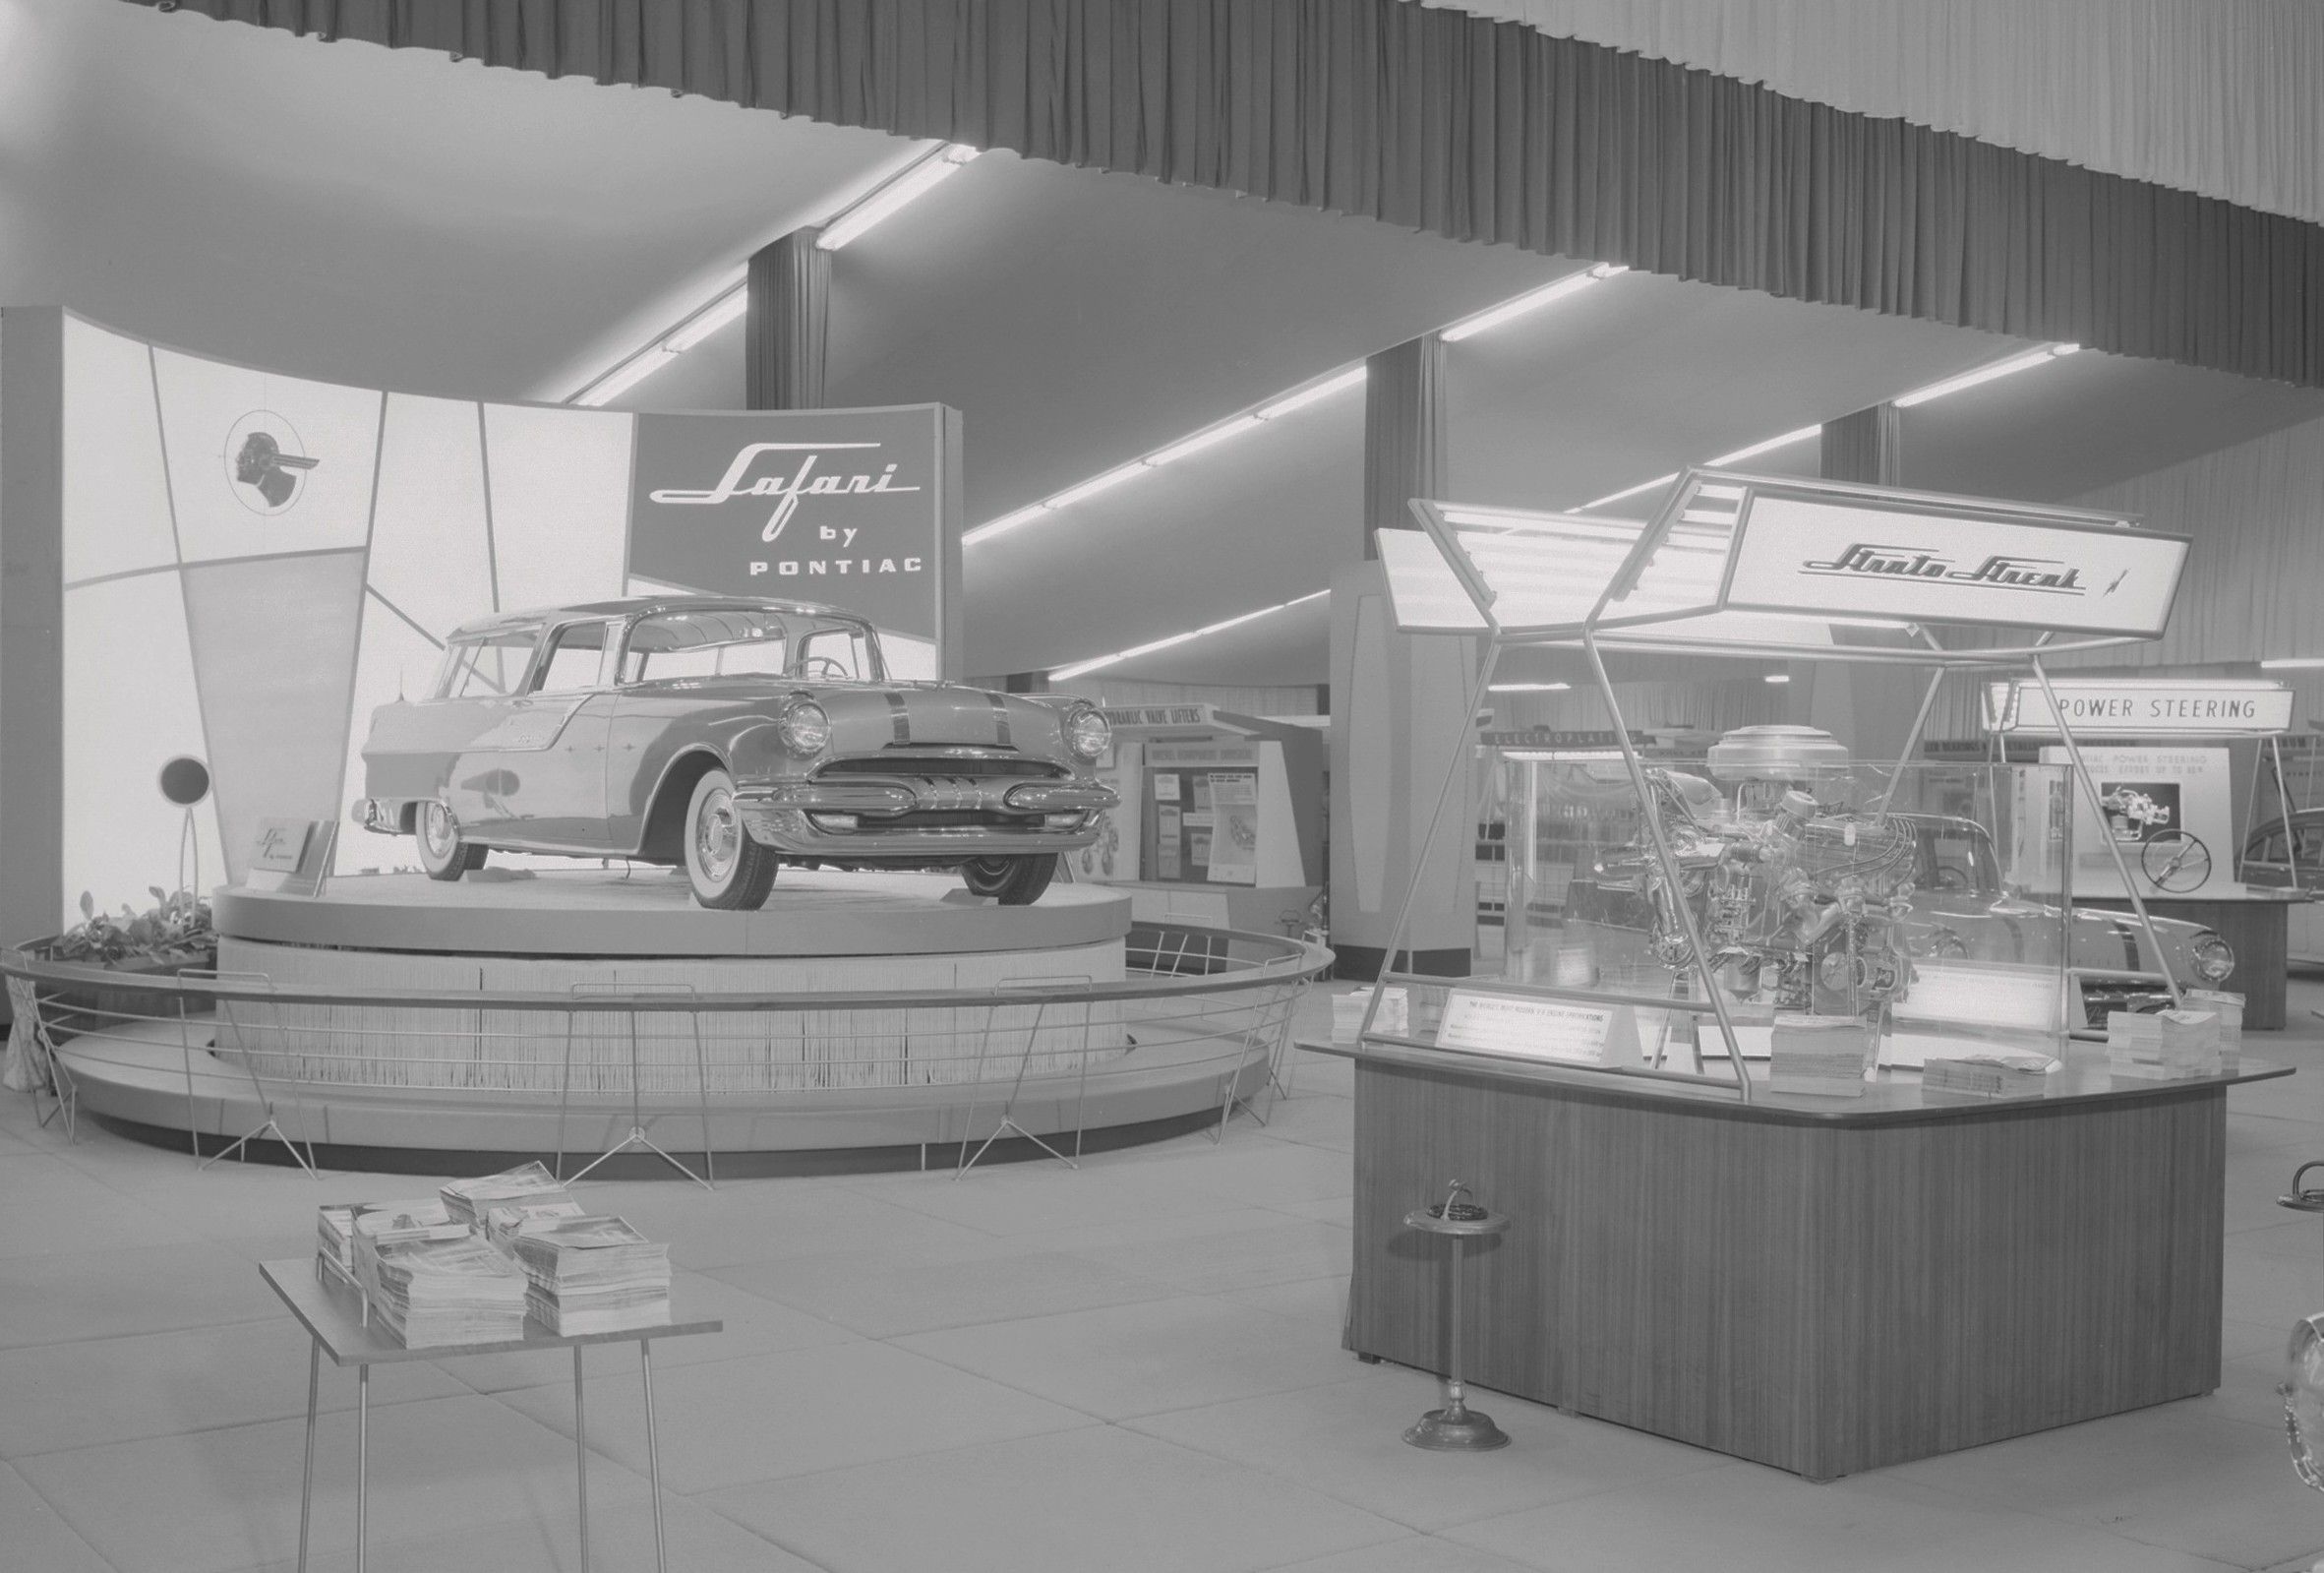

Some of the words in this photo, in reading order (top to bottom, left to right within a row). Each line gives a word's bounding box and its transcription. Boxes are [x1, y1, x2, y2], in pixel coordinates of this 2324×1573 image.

[649, 443, 920, 542] Safari
[819, 525, 858, 548] by
[749, 557, 923, 576] PONTIAC
[1803, 542, 1955, 578] Strato
[1944, 554, 2086, 590] Streak
[1170, 708, 1200, 725] LIFTERS
[2059, 698, 2133, 717] POWER
[2150, 698, 2255, 719] STEERING
[1494, 732, 1638, 745] ELECTROPLATIG
